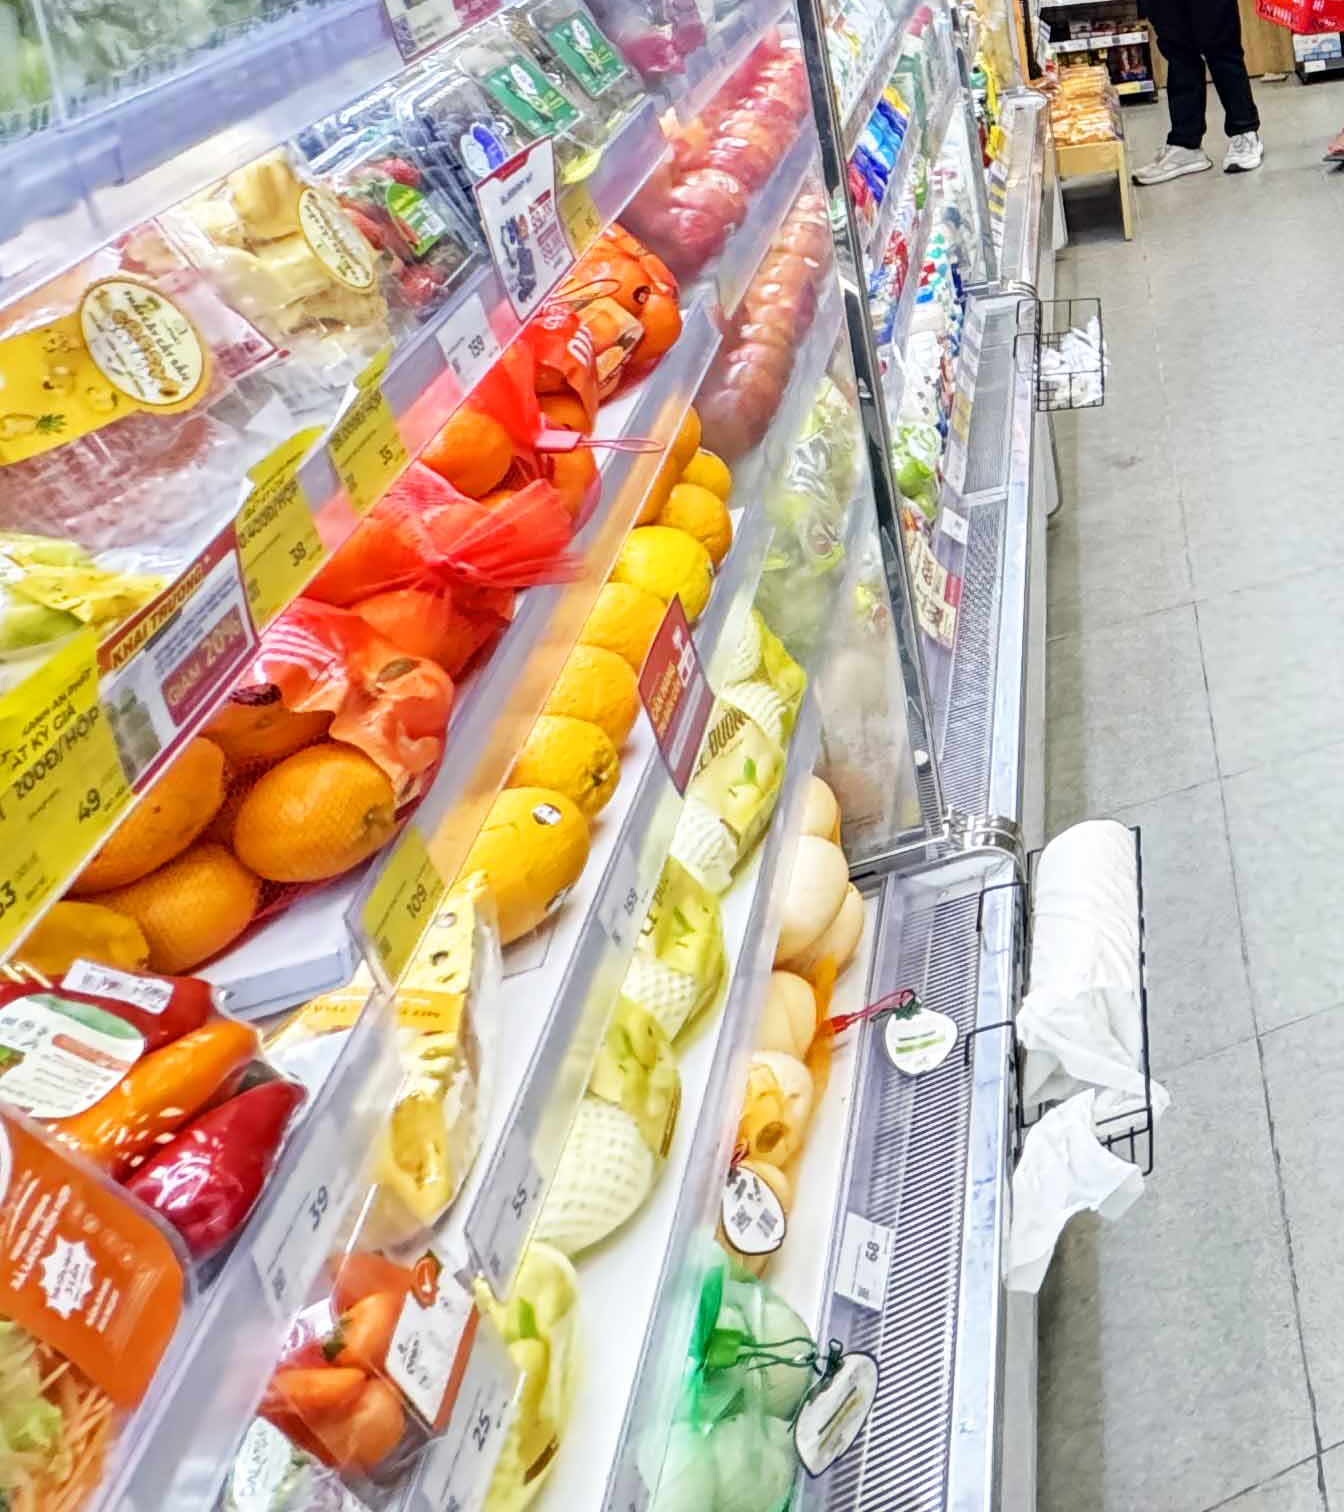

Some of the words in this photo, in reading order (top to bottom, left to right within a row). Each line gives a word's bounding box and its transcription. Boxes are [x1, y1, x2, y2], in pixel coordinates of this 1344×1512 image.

[78, 787, 101, 823] 49
[405, 882, 428, 919] 109
[307, 1185, 329, 1231] 39
[865, 1240, 880, 1263] 68
[471, 1407, 491, 1451] 25
